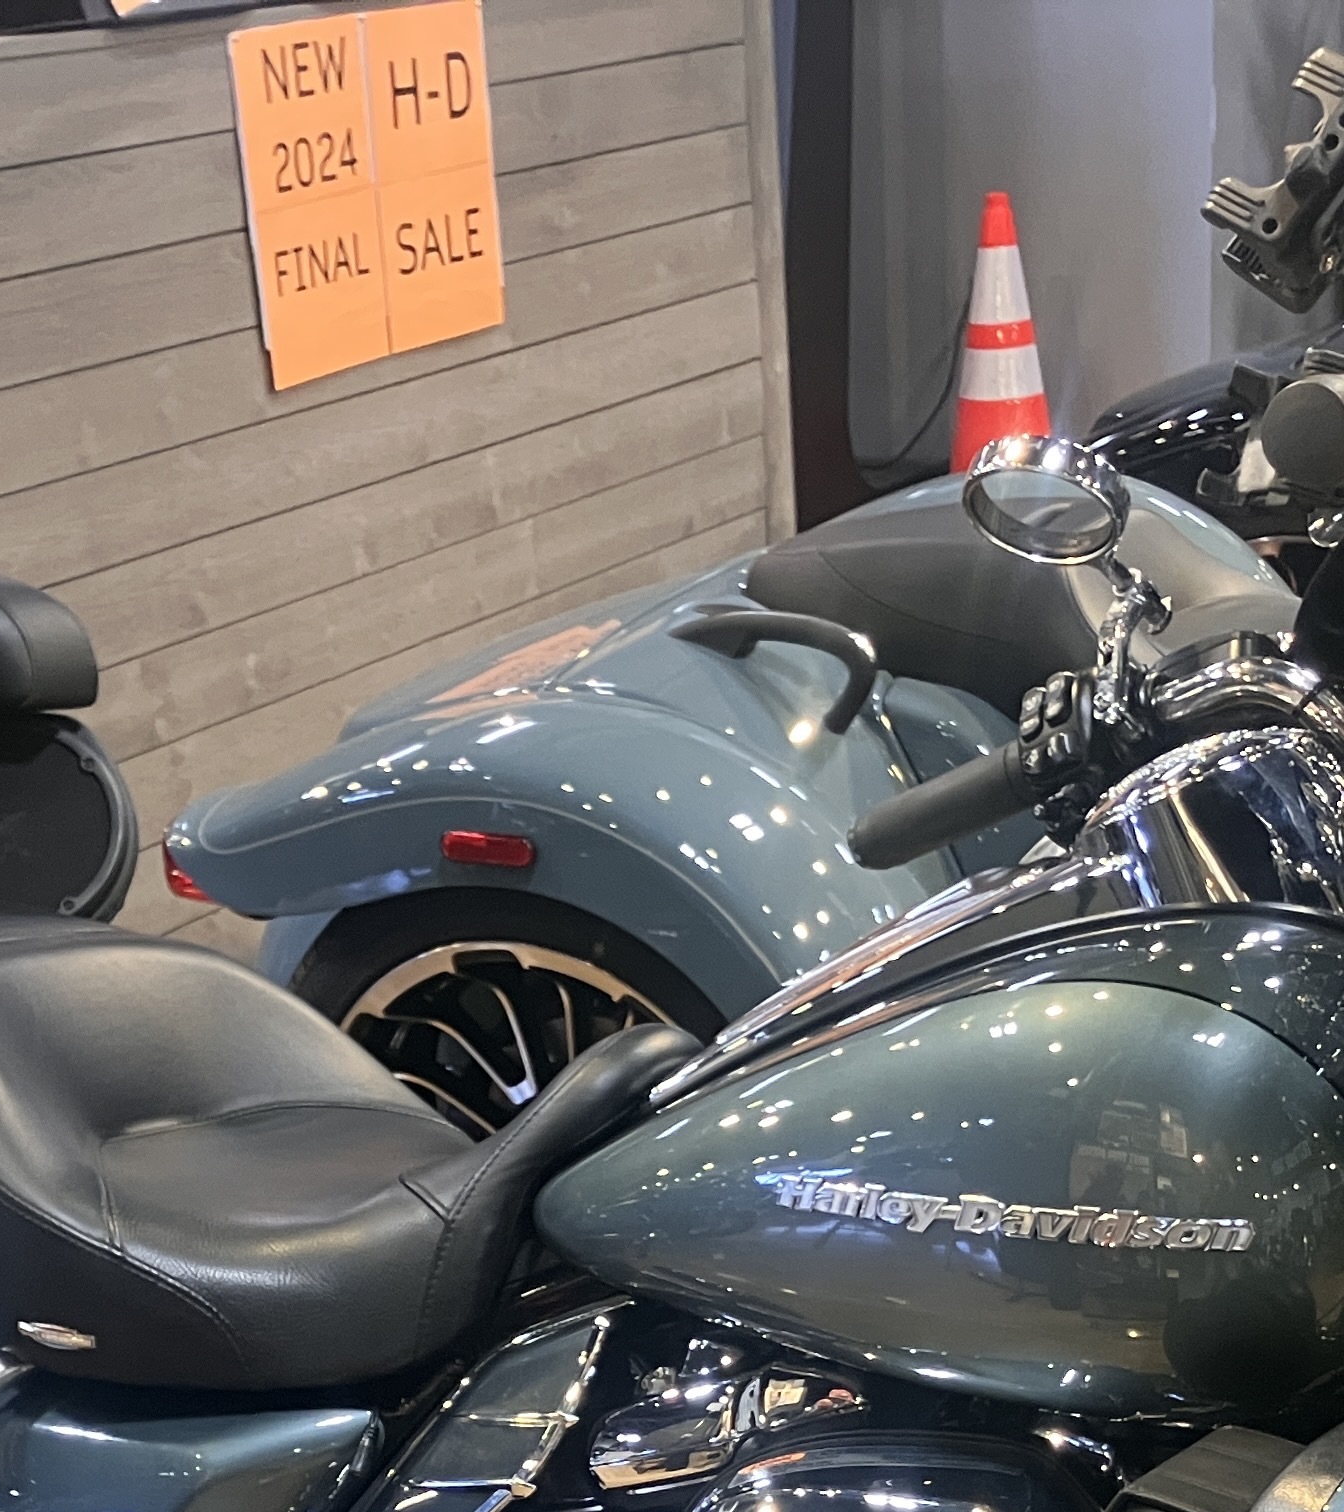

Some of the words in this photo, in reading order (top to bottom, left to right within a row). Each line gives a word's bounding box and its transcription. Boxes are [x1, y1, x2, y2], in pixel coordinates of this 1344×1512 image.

[260, 35, 348, 104] NEW
[387, 50, 473, 130] H-D
[272, 127, 359, 194] 2024
[273, 231, 371, 298] FINAL
[395, 206, 485, 276] SALE
[774, 1174, 1256, 1252] Harley-Davidson
